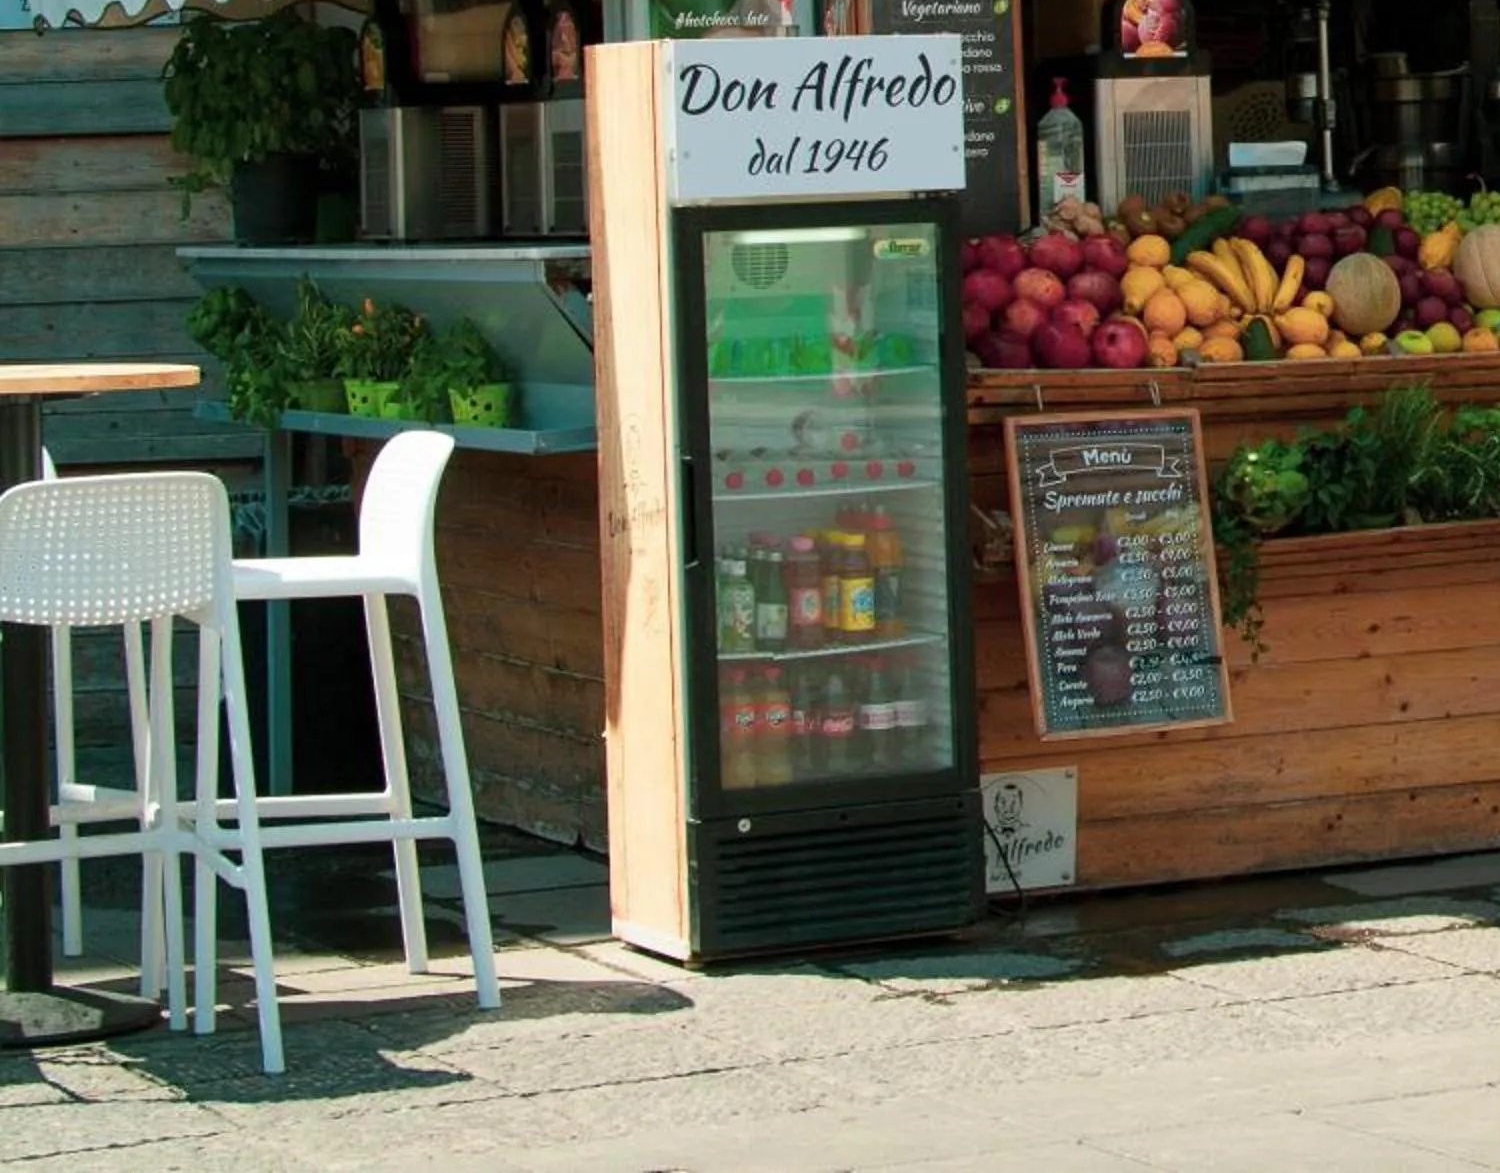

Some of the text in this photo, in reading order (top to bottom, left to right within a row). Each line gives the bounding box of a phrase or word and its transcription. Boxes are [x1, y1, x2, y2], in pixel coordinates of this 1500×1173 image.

[901, 0, 982, 23] Vegetariano
[679, 52, 957, 123] Don Alfredo
[748, 136, 890, 176] dal 1946
[1083, 448, 1132, 466] Menù
[1043, 488, 1120, 514] Spremute
[1123, 493, 1132, 505] e
[995, 829, 1065, 868] Alfredo
